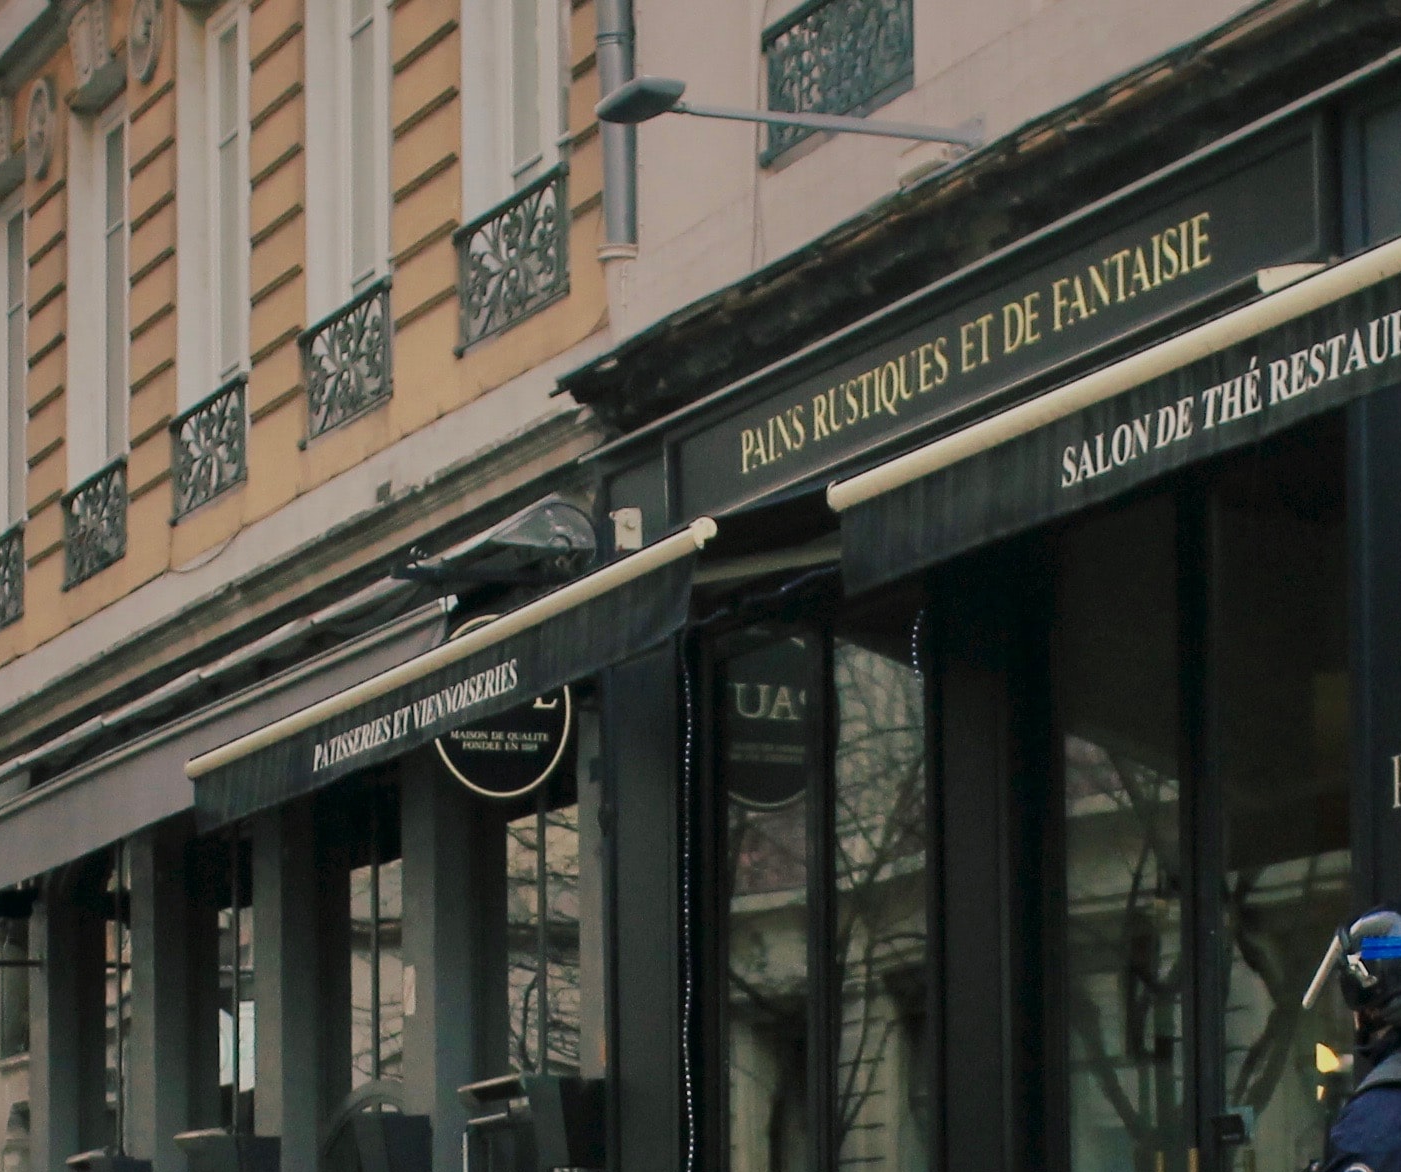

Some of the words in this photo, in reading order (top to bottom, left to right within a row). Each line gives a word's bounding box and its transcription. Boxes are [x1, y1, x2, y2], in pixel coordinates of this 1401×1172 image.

[741, 404, 806, 474] PAINS
[812, 337, 949, 441] RUSTIQUES
[960, 313, 994, 373] ET
[1002, 292, 1041, 354] DE
[1051, 212, 1212, 331] FANTAISIE
[1061, 413, 1152, 488] SALON
[1154, 396, 1195, 449] DE
[1202, 355, 1263, 430] THÉ
[313, 714, 391, 772] PATISSERIES
[392, 705, 414, 739] ET
[412, 658, 518, 729] VIENNOISERIES
[450, 729, 489, 740] MAISON
[491, 730, 504, 740] DE
[504, 741, 519, 751] EN
